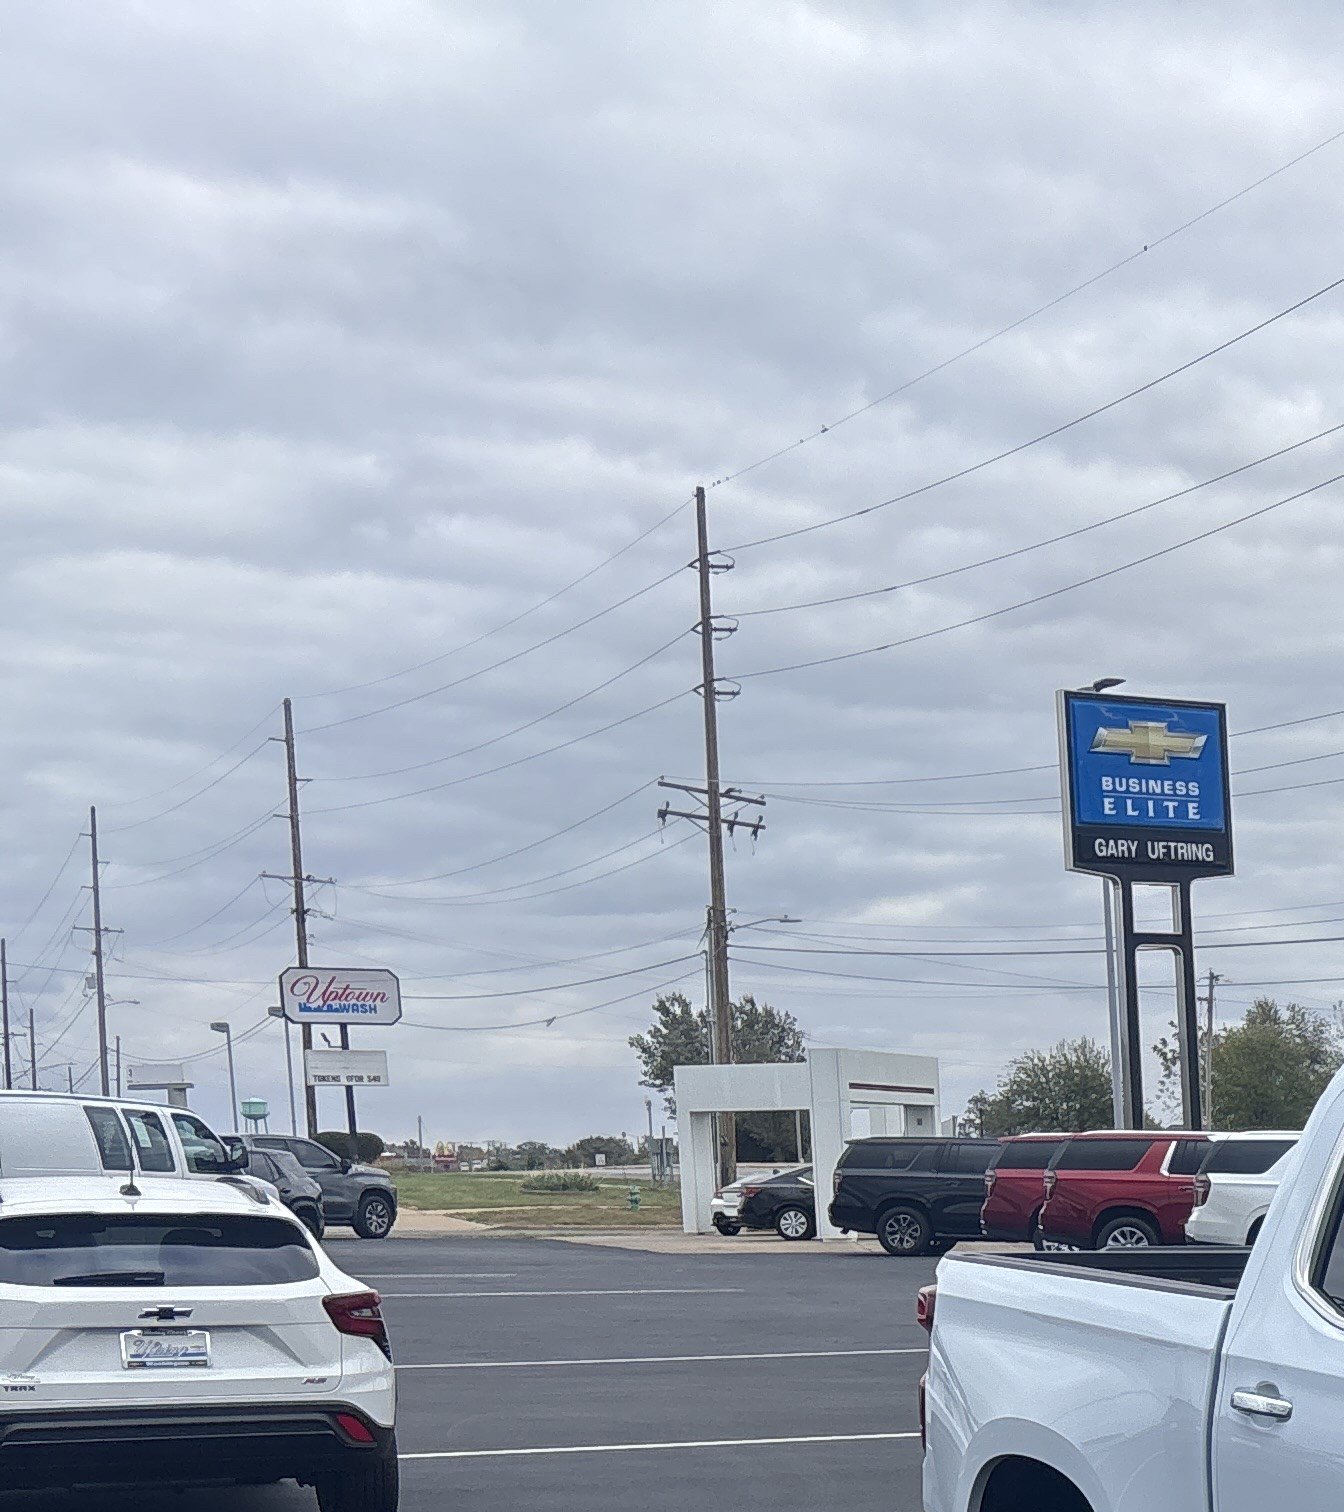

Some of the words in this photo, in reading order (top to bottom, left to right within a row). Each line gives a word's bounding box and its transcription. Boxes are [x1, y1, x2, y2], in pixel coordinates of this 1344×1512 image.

[1101, 776, 1200, 796] BUSINESS
[1103, 798, 1200, 819] ELITE
[1094, 838, 1138, 858] GARY
[1147, 841, 1214, 862] UFTRING
[290, 974, 390, 1008] Uptown
[339, 1003, 378, 1014] WASH
